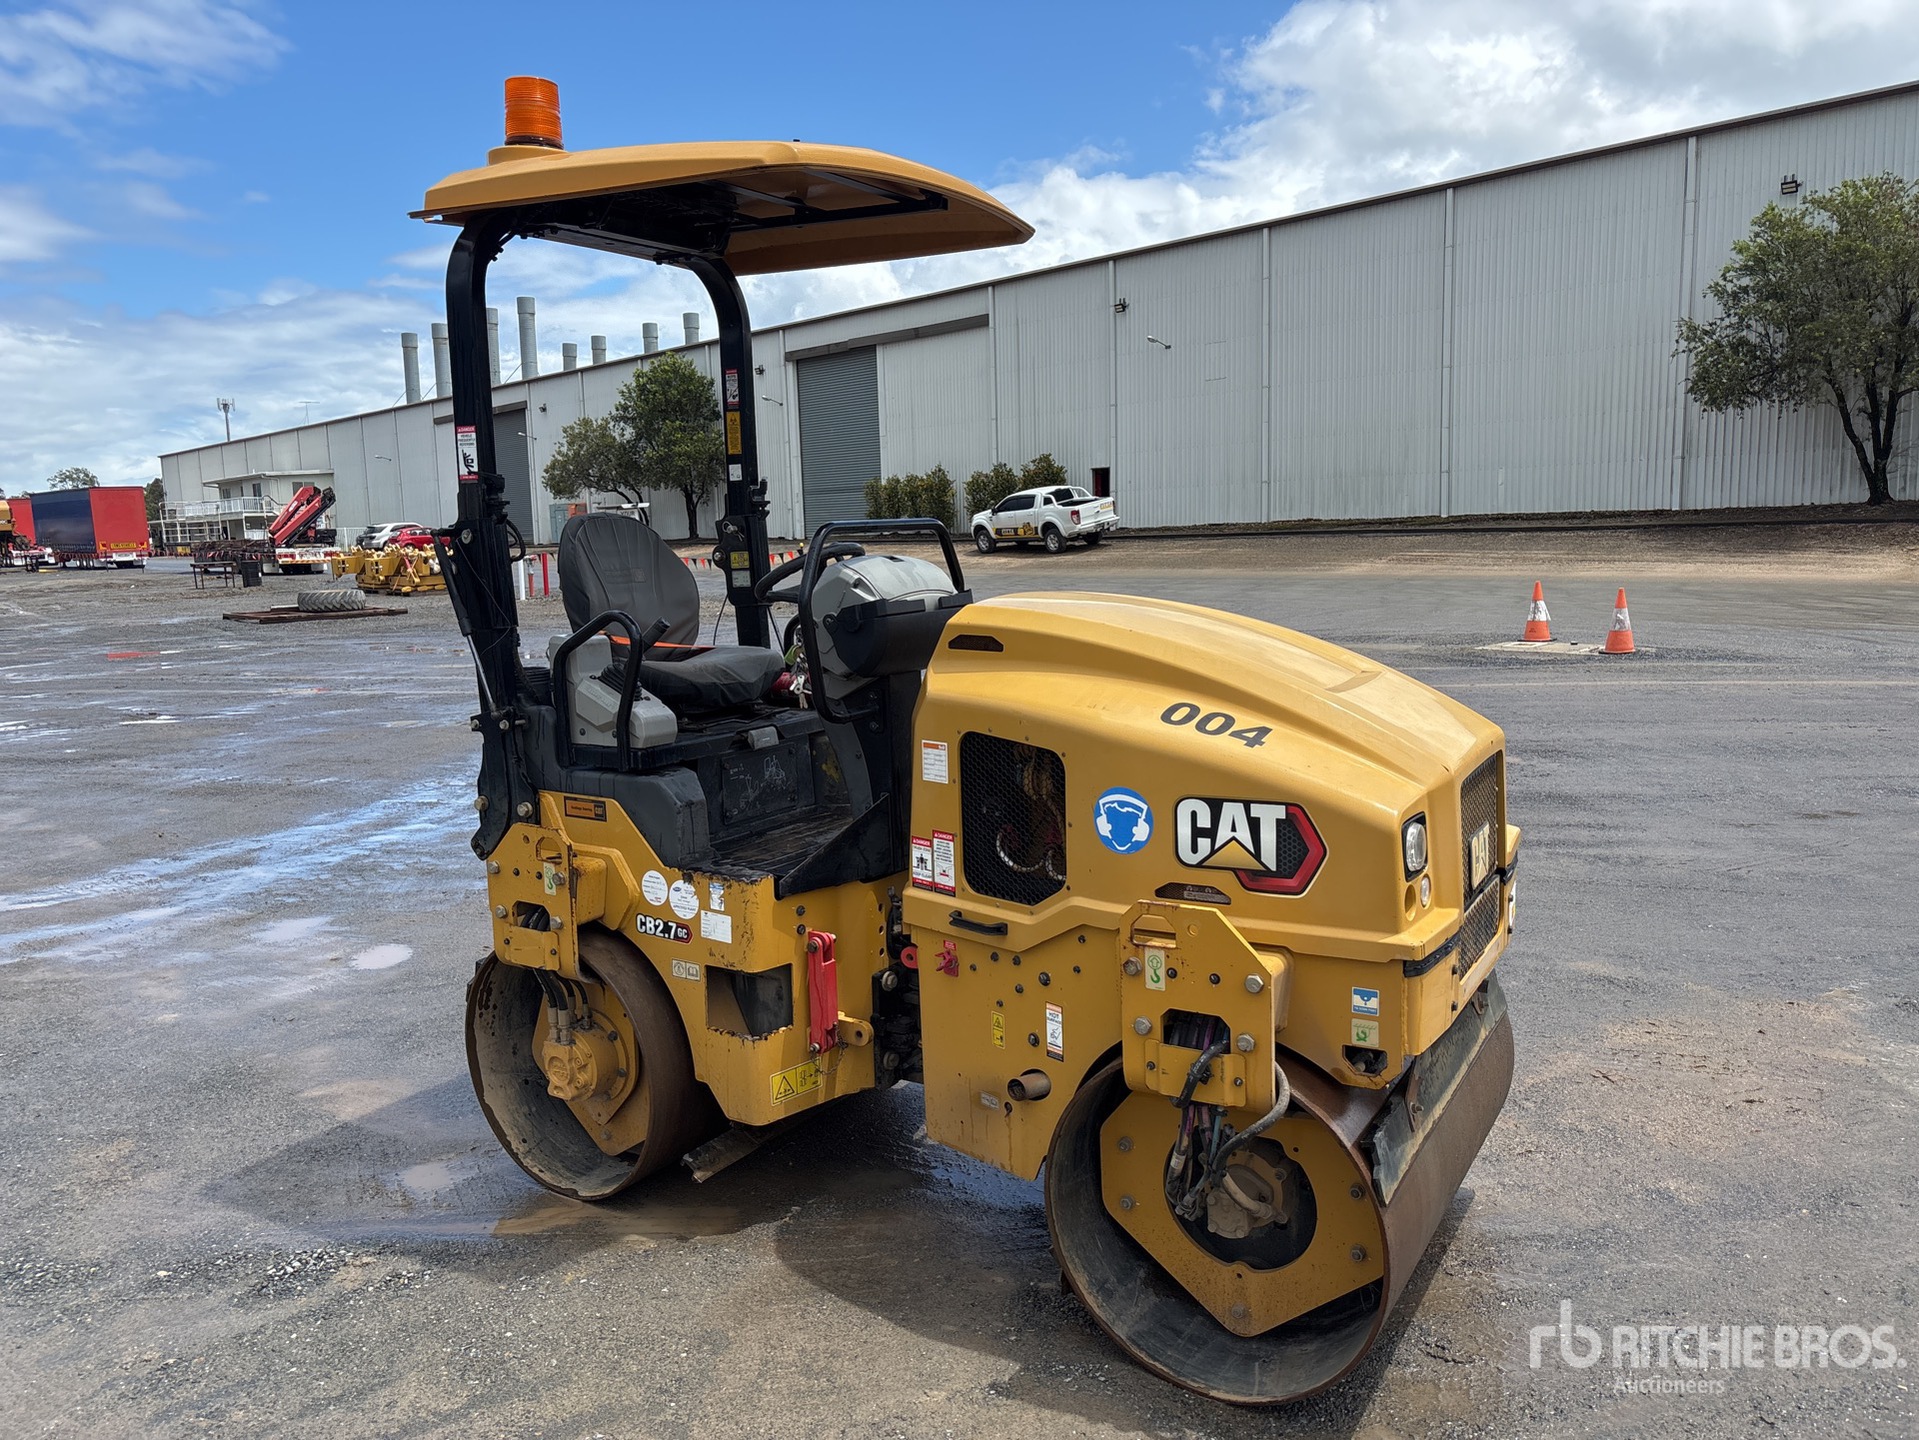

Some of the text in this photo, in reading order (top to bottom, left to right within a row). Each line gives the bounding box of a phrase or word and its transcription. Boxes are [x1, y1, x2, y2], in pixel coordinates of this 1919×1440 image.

[1160, 702, 1273, 748] 004
[915, 838, 931, 846] DANGER
[1177, 798, 1286, 872] CAT
[1471, 823, 1490, 886] CAT
[636, 914, 688, 940] CB2.7 GC
